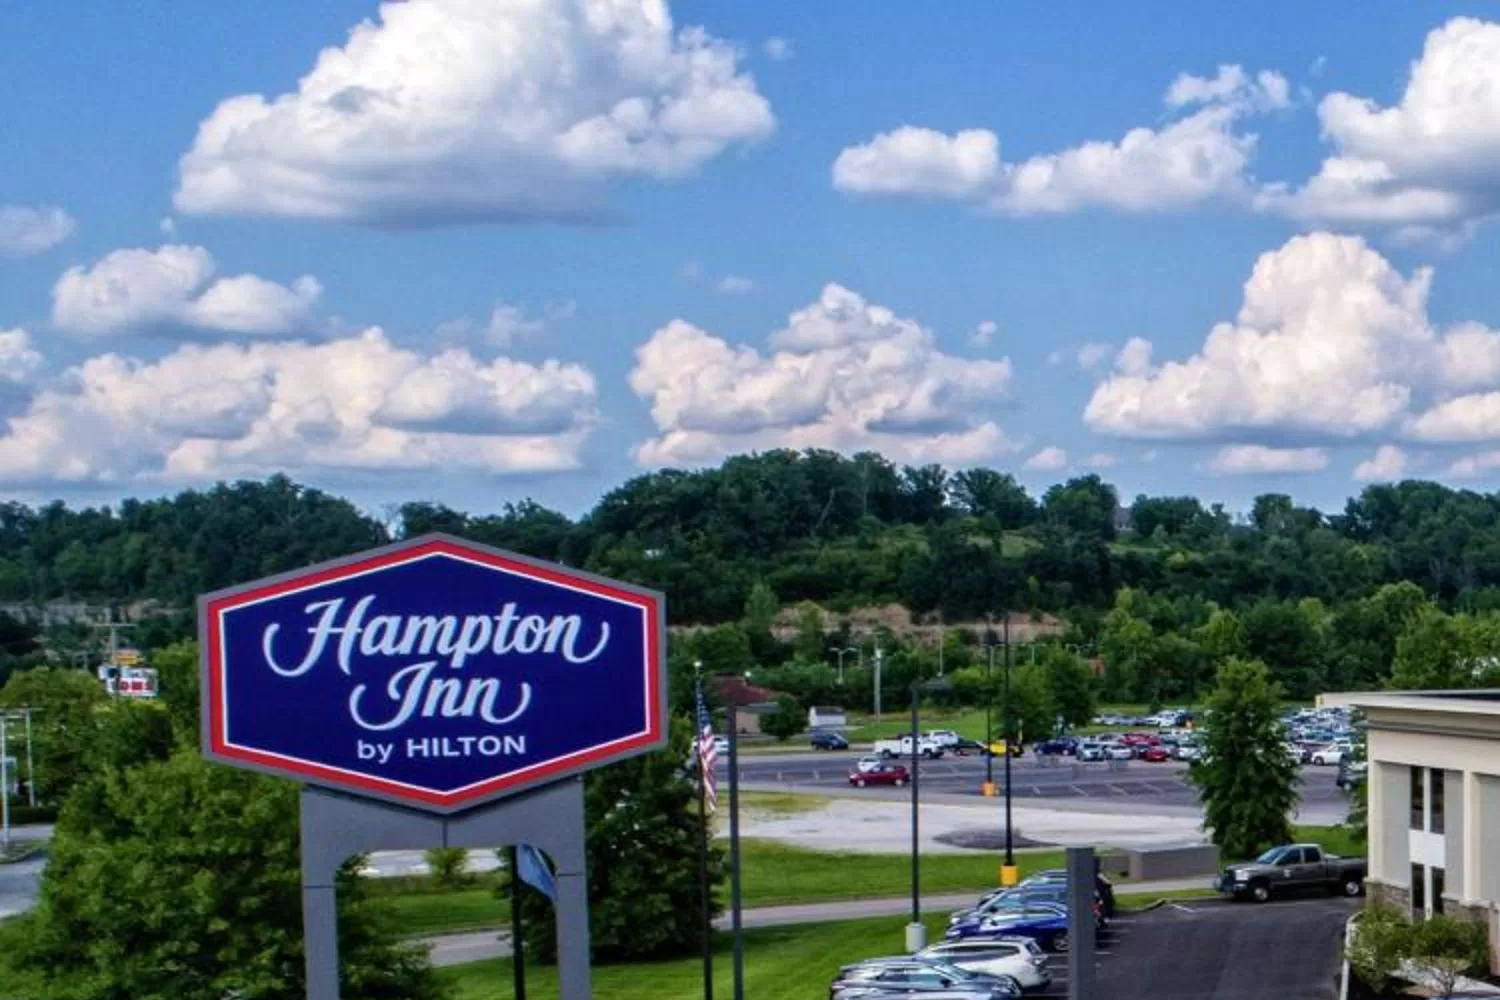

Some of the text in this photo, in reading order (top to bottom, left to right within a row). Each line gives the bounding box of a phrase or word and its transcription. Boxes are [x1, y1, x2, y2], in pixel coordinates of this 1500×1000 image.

[262, 593, 611, 677] Hampton
[349, 660, 532, 731] Inn
[356, 735, 527, 764] by HILTON
